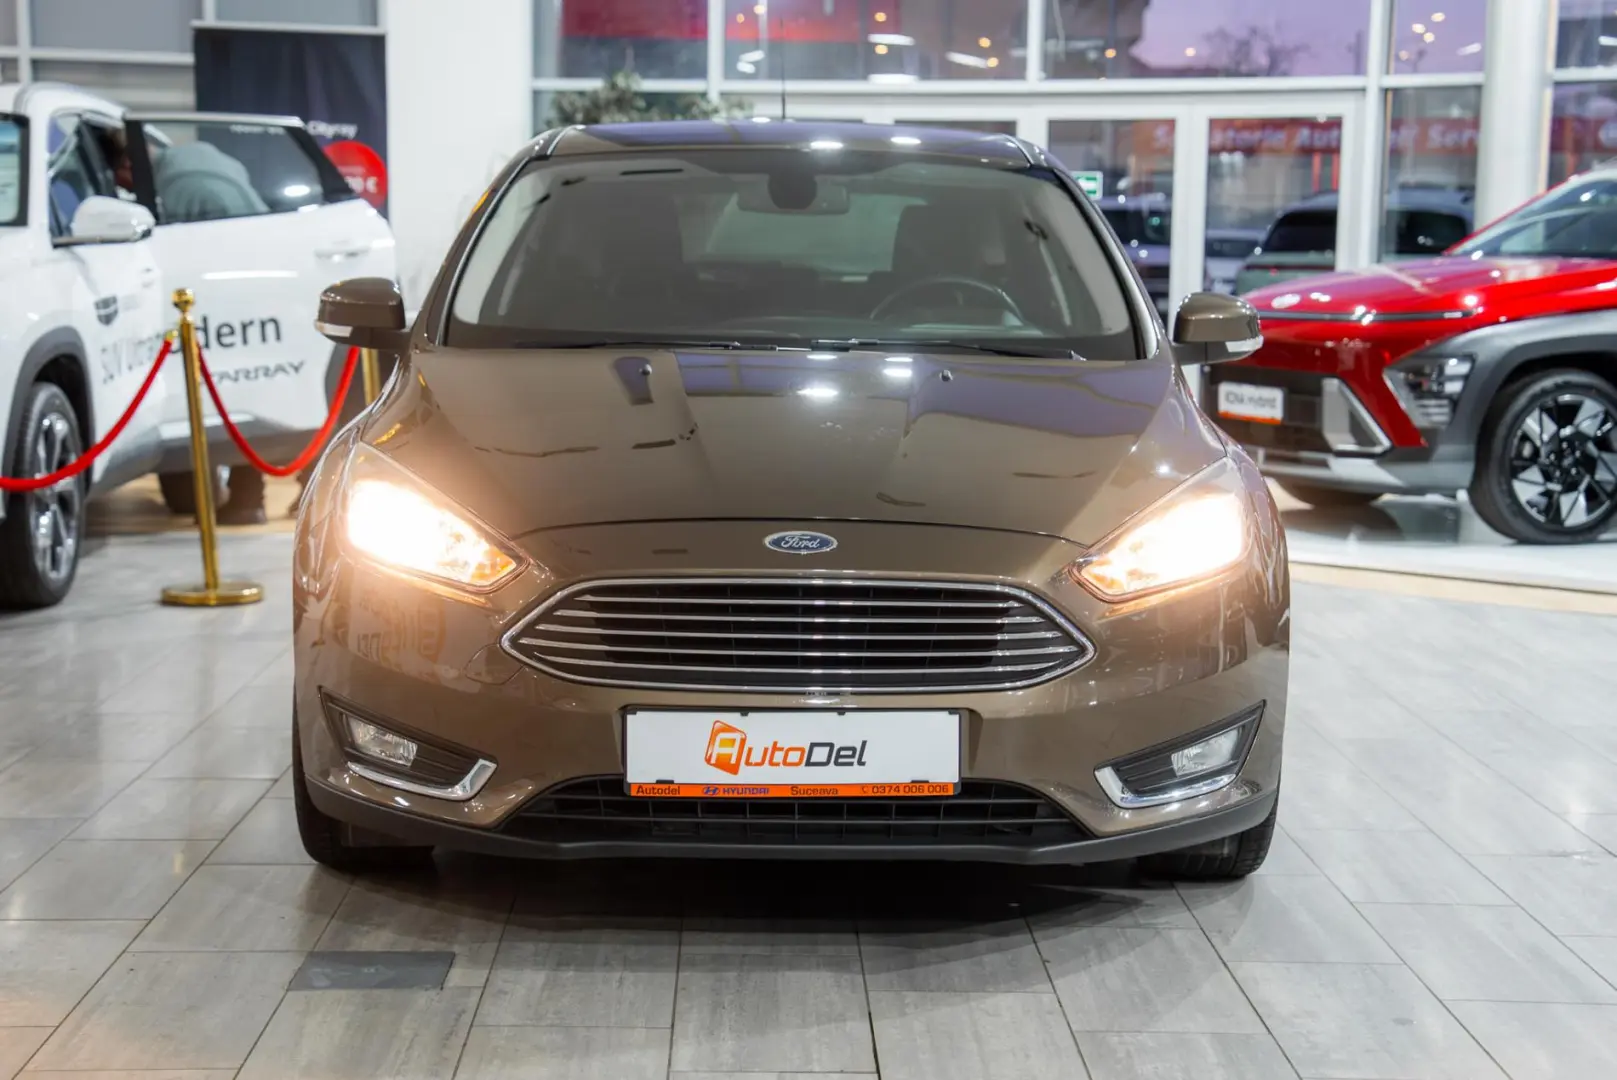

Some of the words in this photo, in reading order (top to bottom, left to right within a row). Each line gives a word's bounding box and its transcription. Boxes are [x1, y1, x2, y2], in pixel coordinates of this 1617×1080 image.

[781, 535, 820, 548] Ford
[707, 726, 868, 770] AutoDel
[636, 785, 681, 796] Autodel
[723, 787, 769, 795] HYUNDAI
[790, 786, 838, 796] Suceava
[872, 785, 900, 794] 0374
[903, 785, 924, 794] 006
[927, 784, 948, 793] 006
